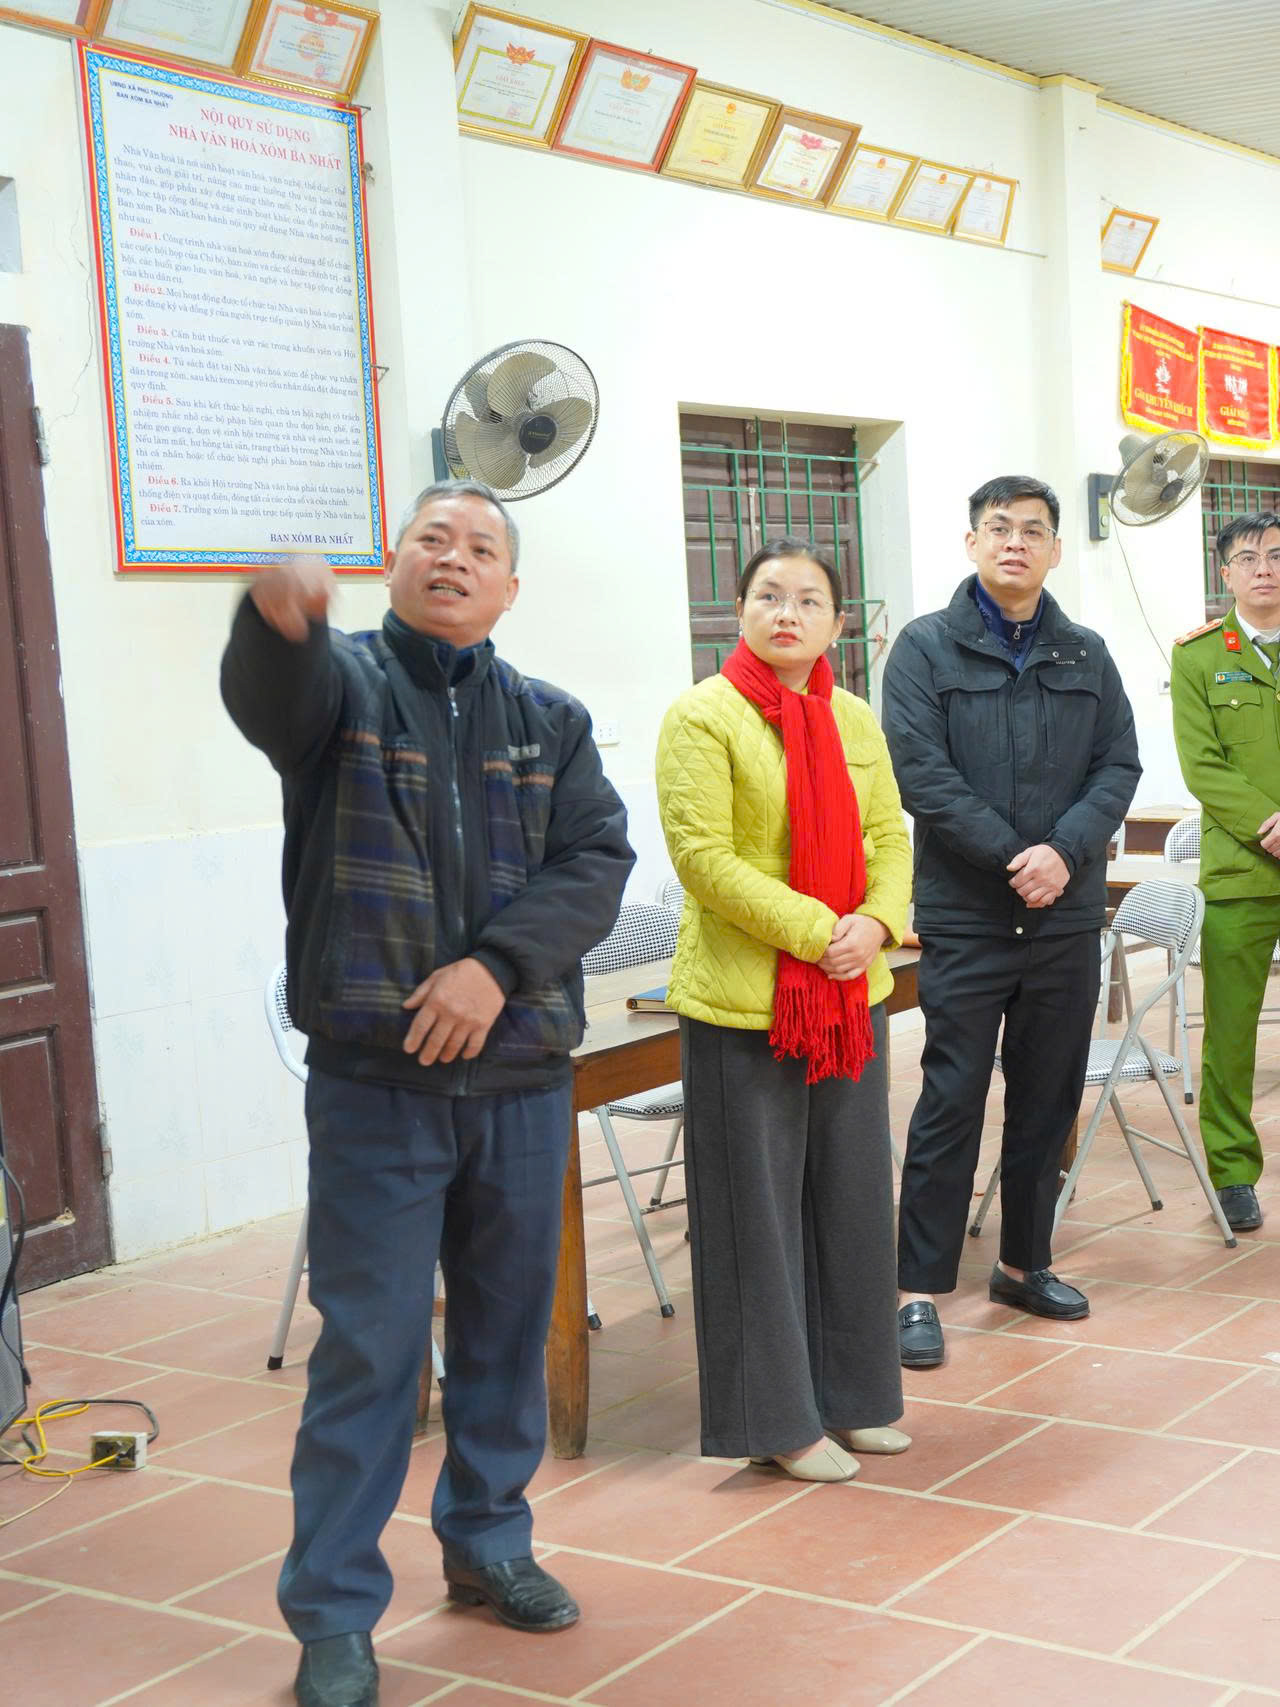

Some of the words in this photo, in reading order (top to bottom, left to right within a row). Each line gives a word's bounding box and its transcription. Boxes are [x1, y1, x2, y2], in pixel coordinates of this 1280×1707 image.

[201, 107, 223, 126] NỘI
[228, 115, 252, 130] QUY
[257, 121, 272, 134] SỬ
[277, 126, 310, 142] DỤNG
[169, 124, 197, 141] NHÀ
[201, 131, 226, 146] VĂN
[260, 143, 286, 159] XÓM
[291, 150, 305, 163] BA
[310, 154, 341, 170] NHẤT
[129, 226, 151, 240] Điều
[133, 282, 155, 294] Điều
[136, 324, 159, 336] Điều
[138, 352, 160, 364] Điều
[141, 394, 163, 405] Điều
[147, 474, 169, 485] Điều
[149, 502, 171, 512] Điều
[173, 504, 181, 513] 7.
[271, 534, 289, 542] BAN
[292, 532, 312, 543] XÓM
[315, 535, 327, 543] BA
[329, 532, 353, 544] NHẤT
